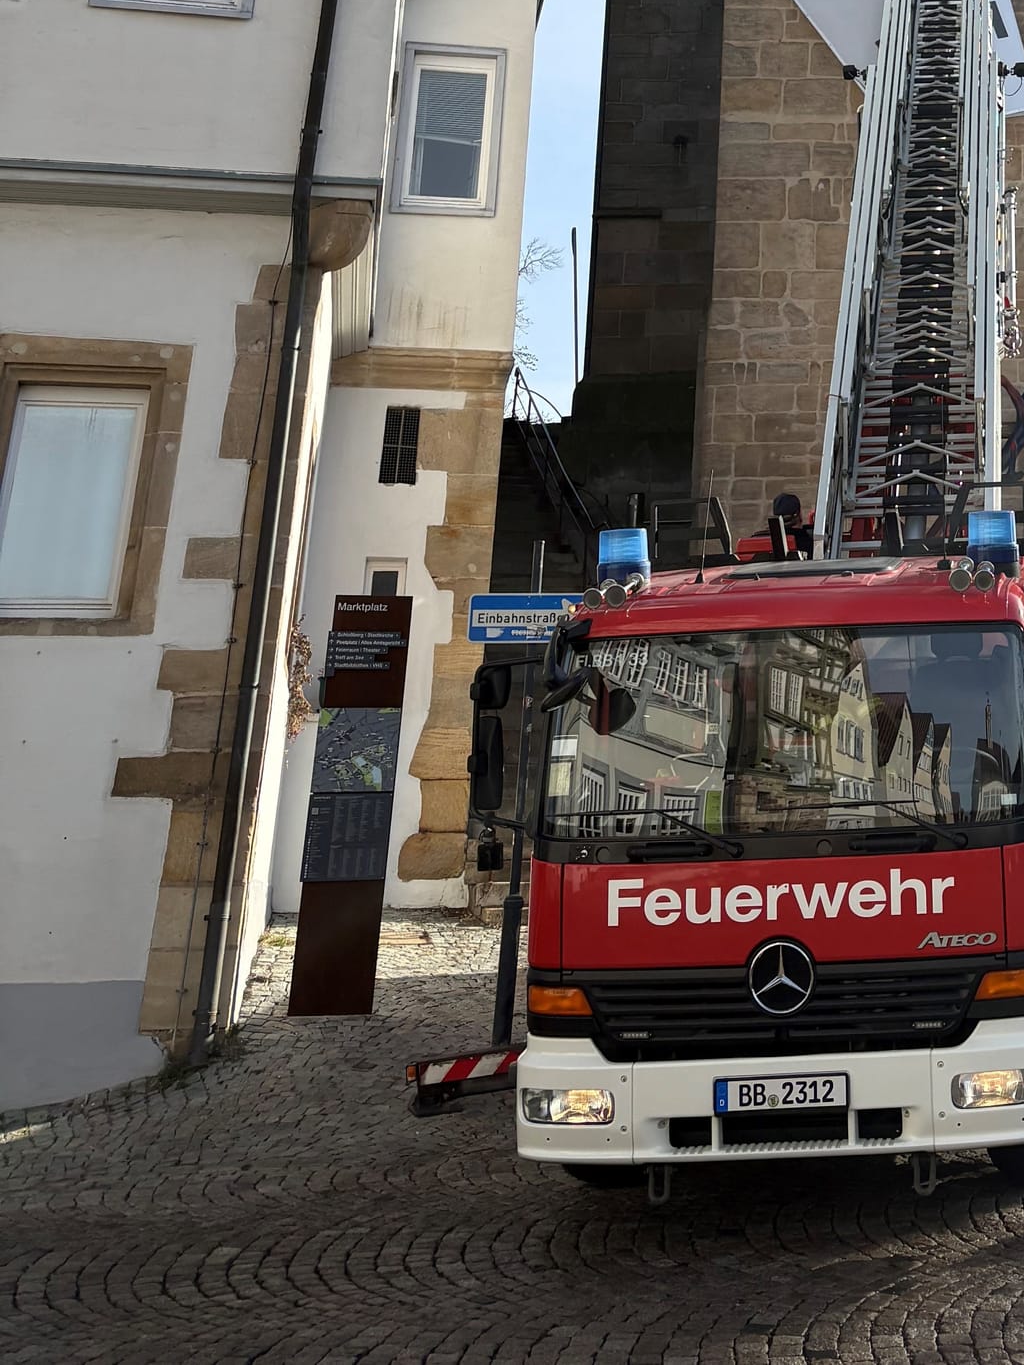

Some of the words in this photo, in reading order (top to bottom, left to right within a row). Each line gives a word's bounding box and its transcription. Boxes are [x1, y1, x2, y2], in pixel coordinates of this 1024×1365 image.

[337, 602, 389, 613] Marktplatz
[607, 868, 955, 927] Feuerwehr
[738, 1083, 767, 1107] BB
[781, 1079, 835, 1105] 2312
